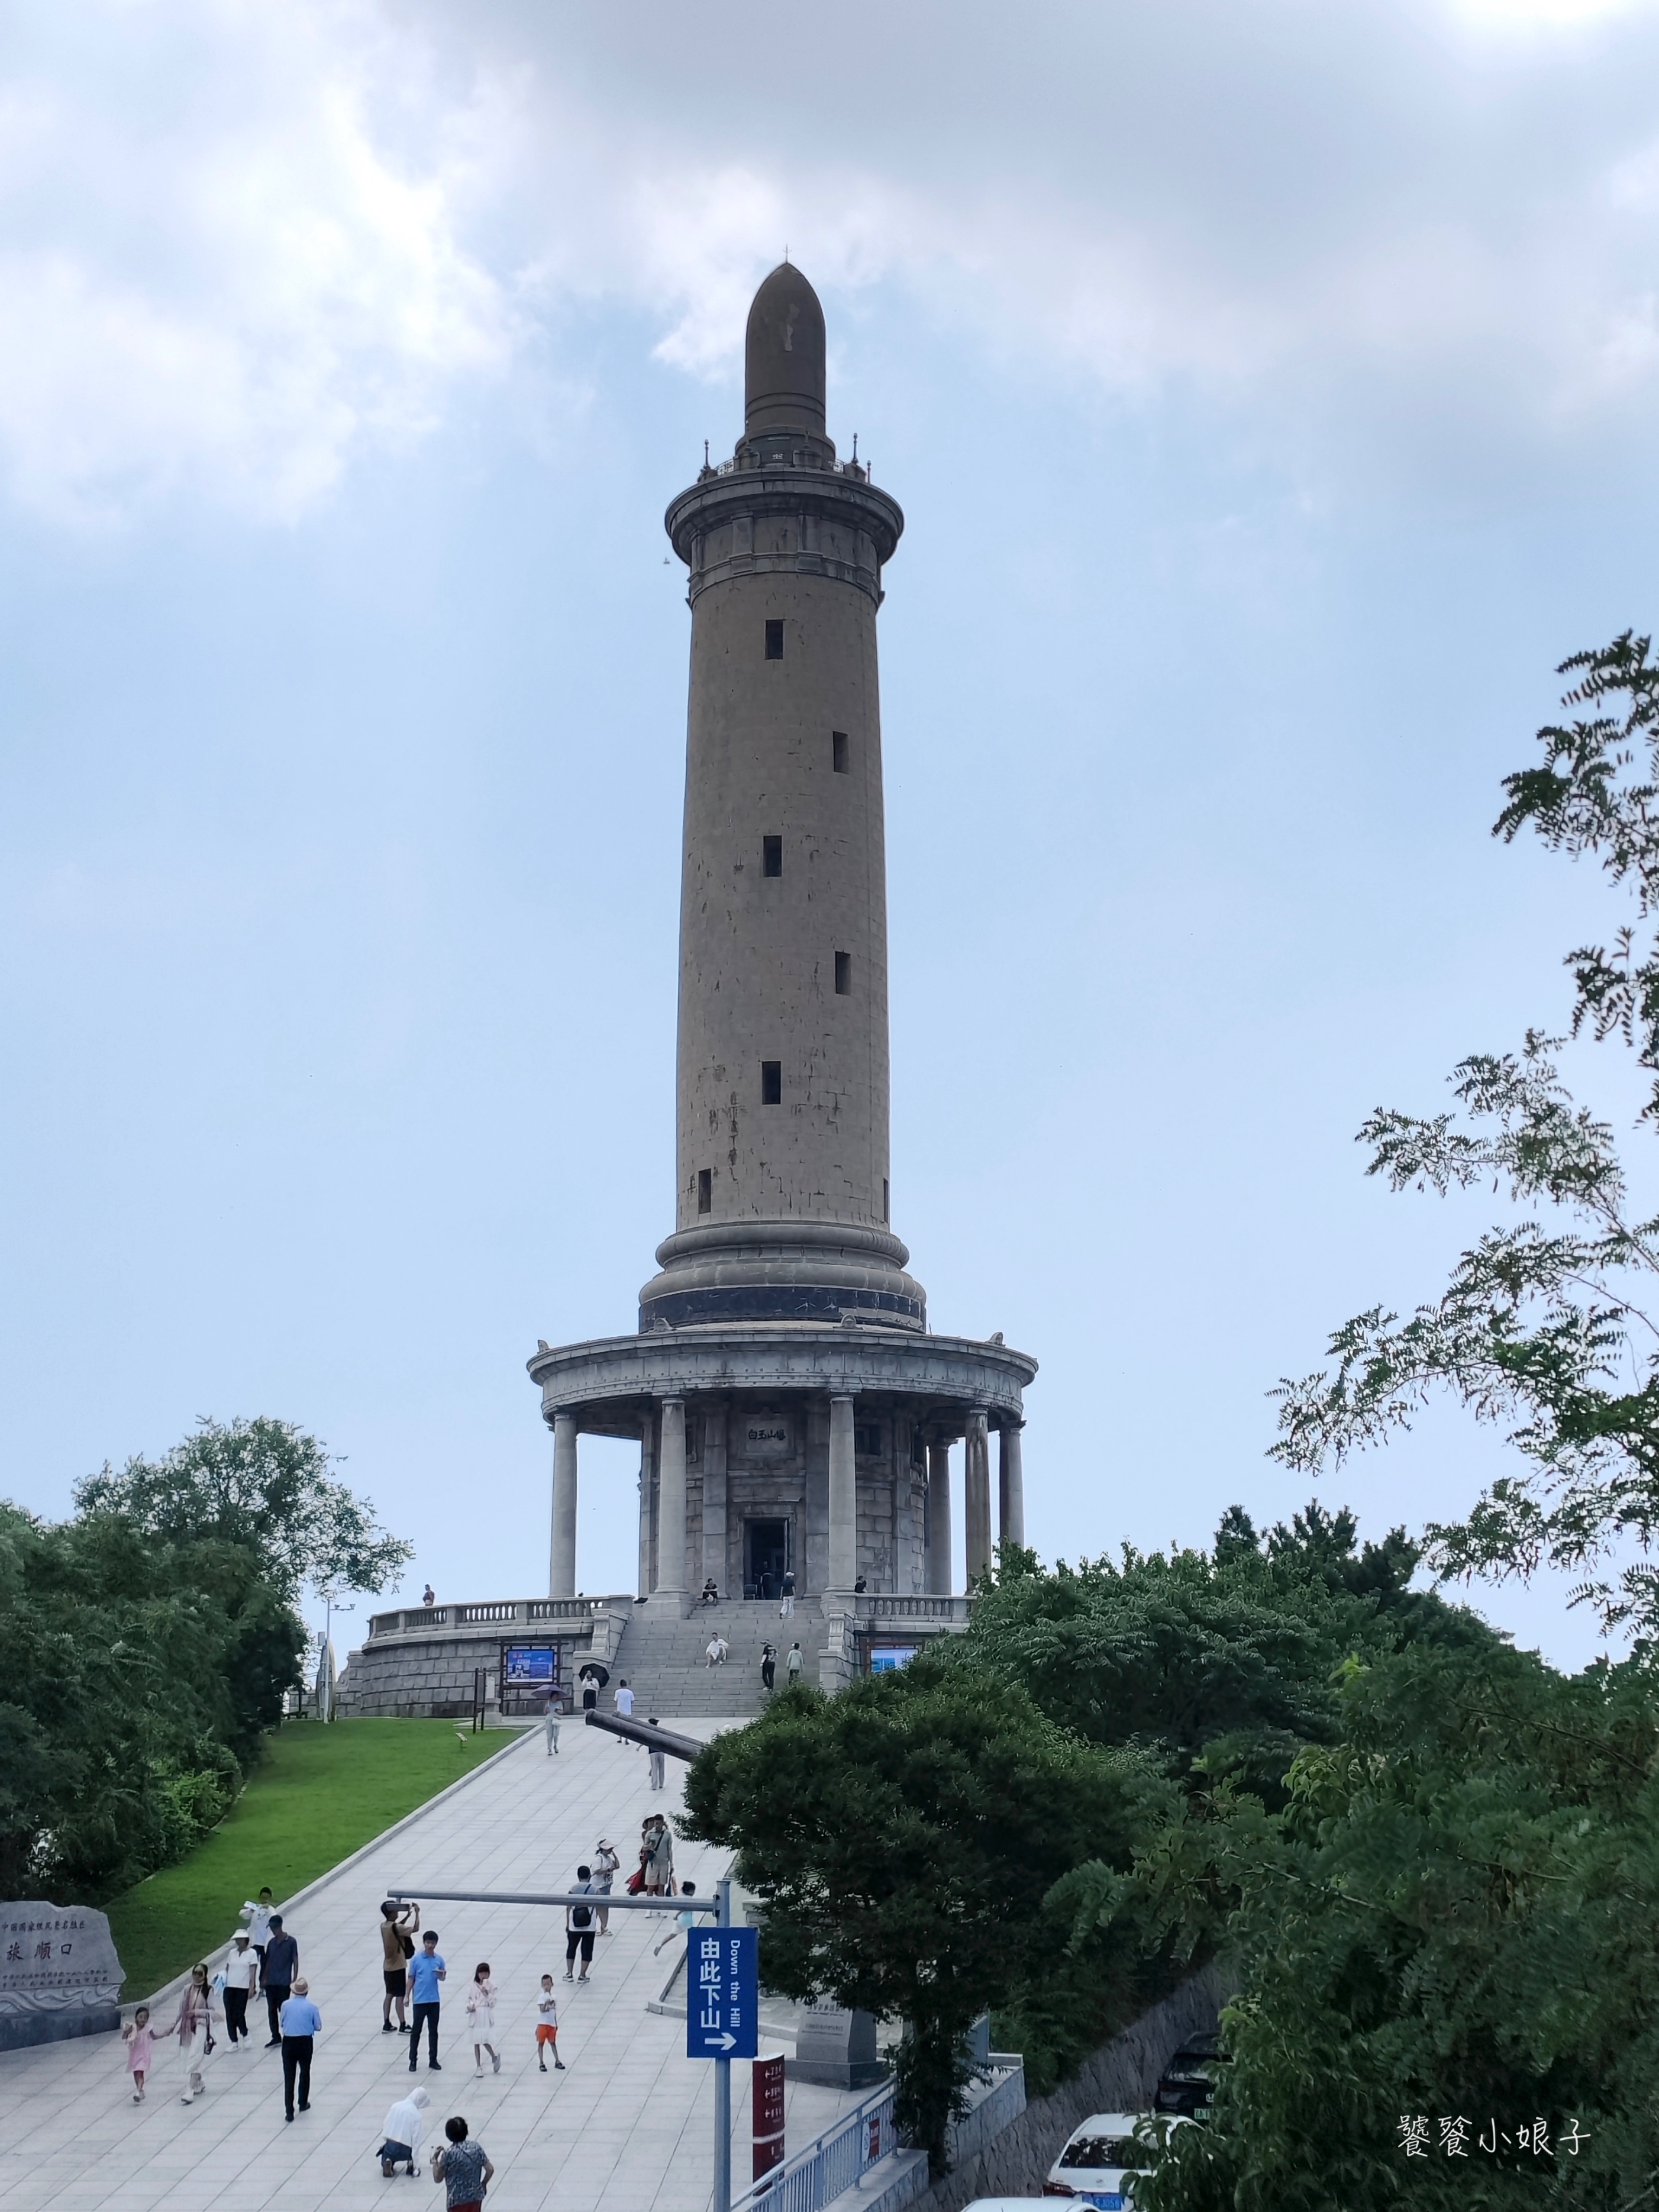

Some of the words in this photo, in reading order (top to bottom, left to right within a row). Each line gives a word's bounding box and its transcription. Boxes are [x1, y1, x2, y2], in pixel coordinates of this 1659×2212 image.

[7, 1941, 72, 1961] 旅顺口
[730, 1940, 741, 1975] Down
[700, 1937, 721, 2029] 由此下山
[730, 1981, 741, 2001] the
[730, 2008, 741, 2027] Hill
